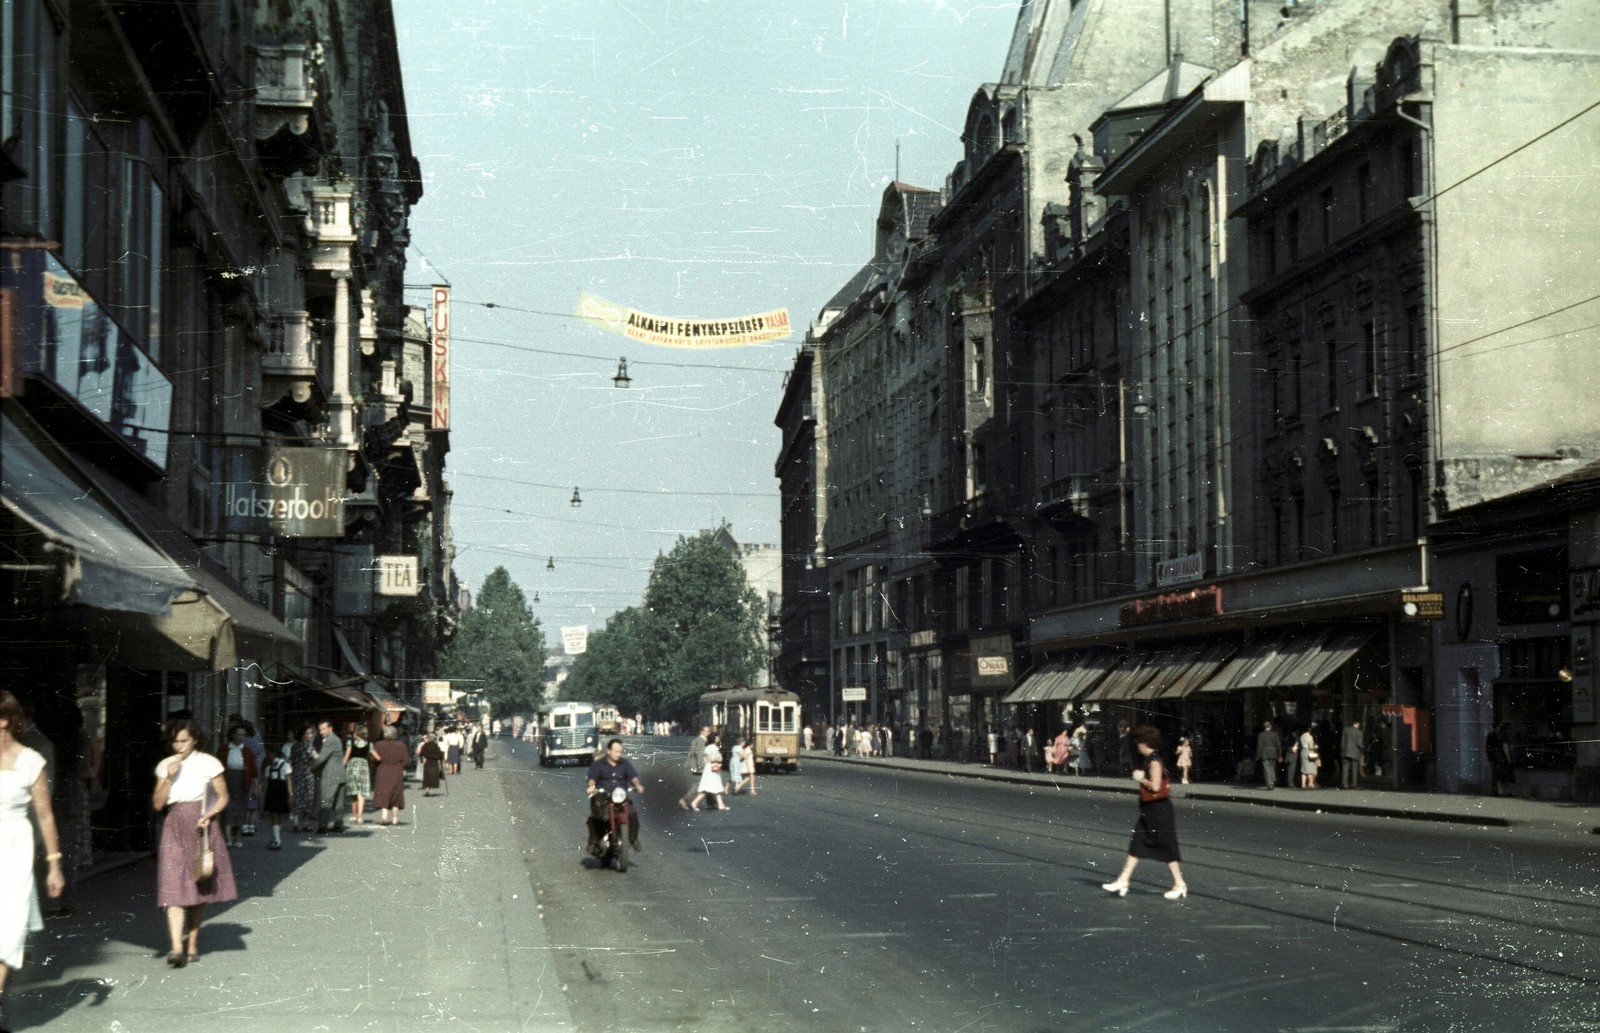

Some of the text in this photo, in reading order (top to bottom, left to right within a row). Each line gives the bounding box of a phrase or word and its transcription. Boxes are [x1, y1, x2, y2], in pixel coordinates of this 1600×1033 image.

[627, 313, 674, 335] ALKALMI
[434, 289, 448, 429] PUSKIN
[384, 562, 411, 587] TEA
